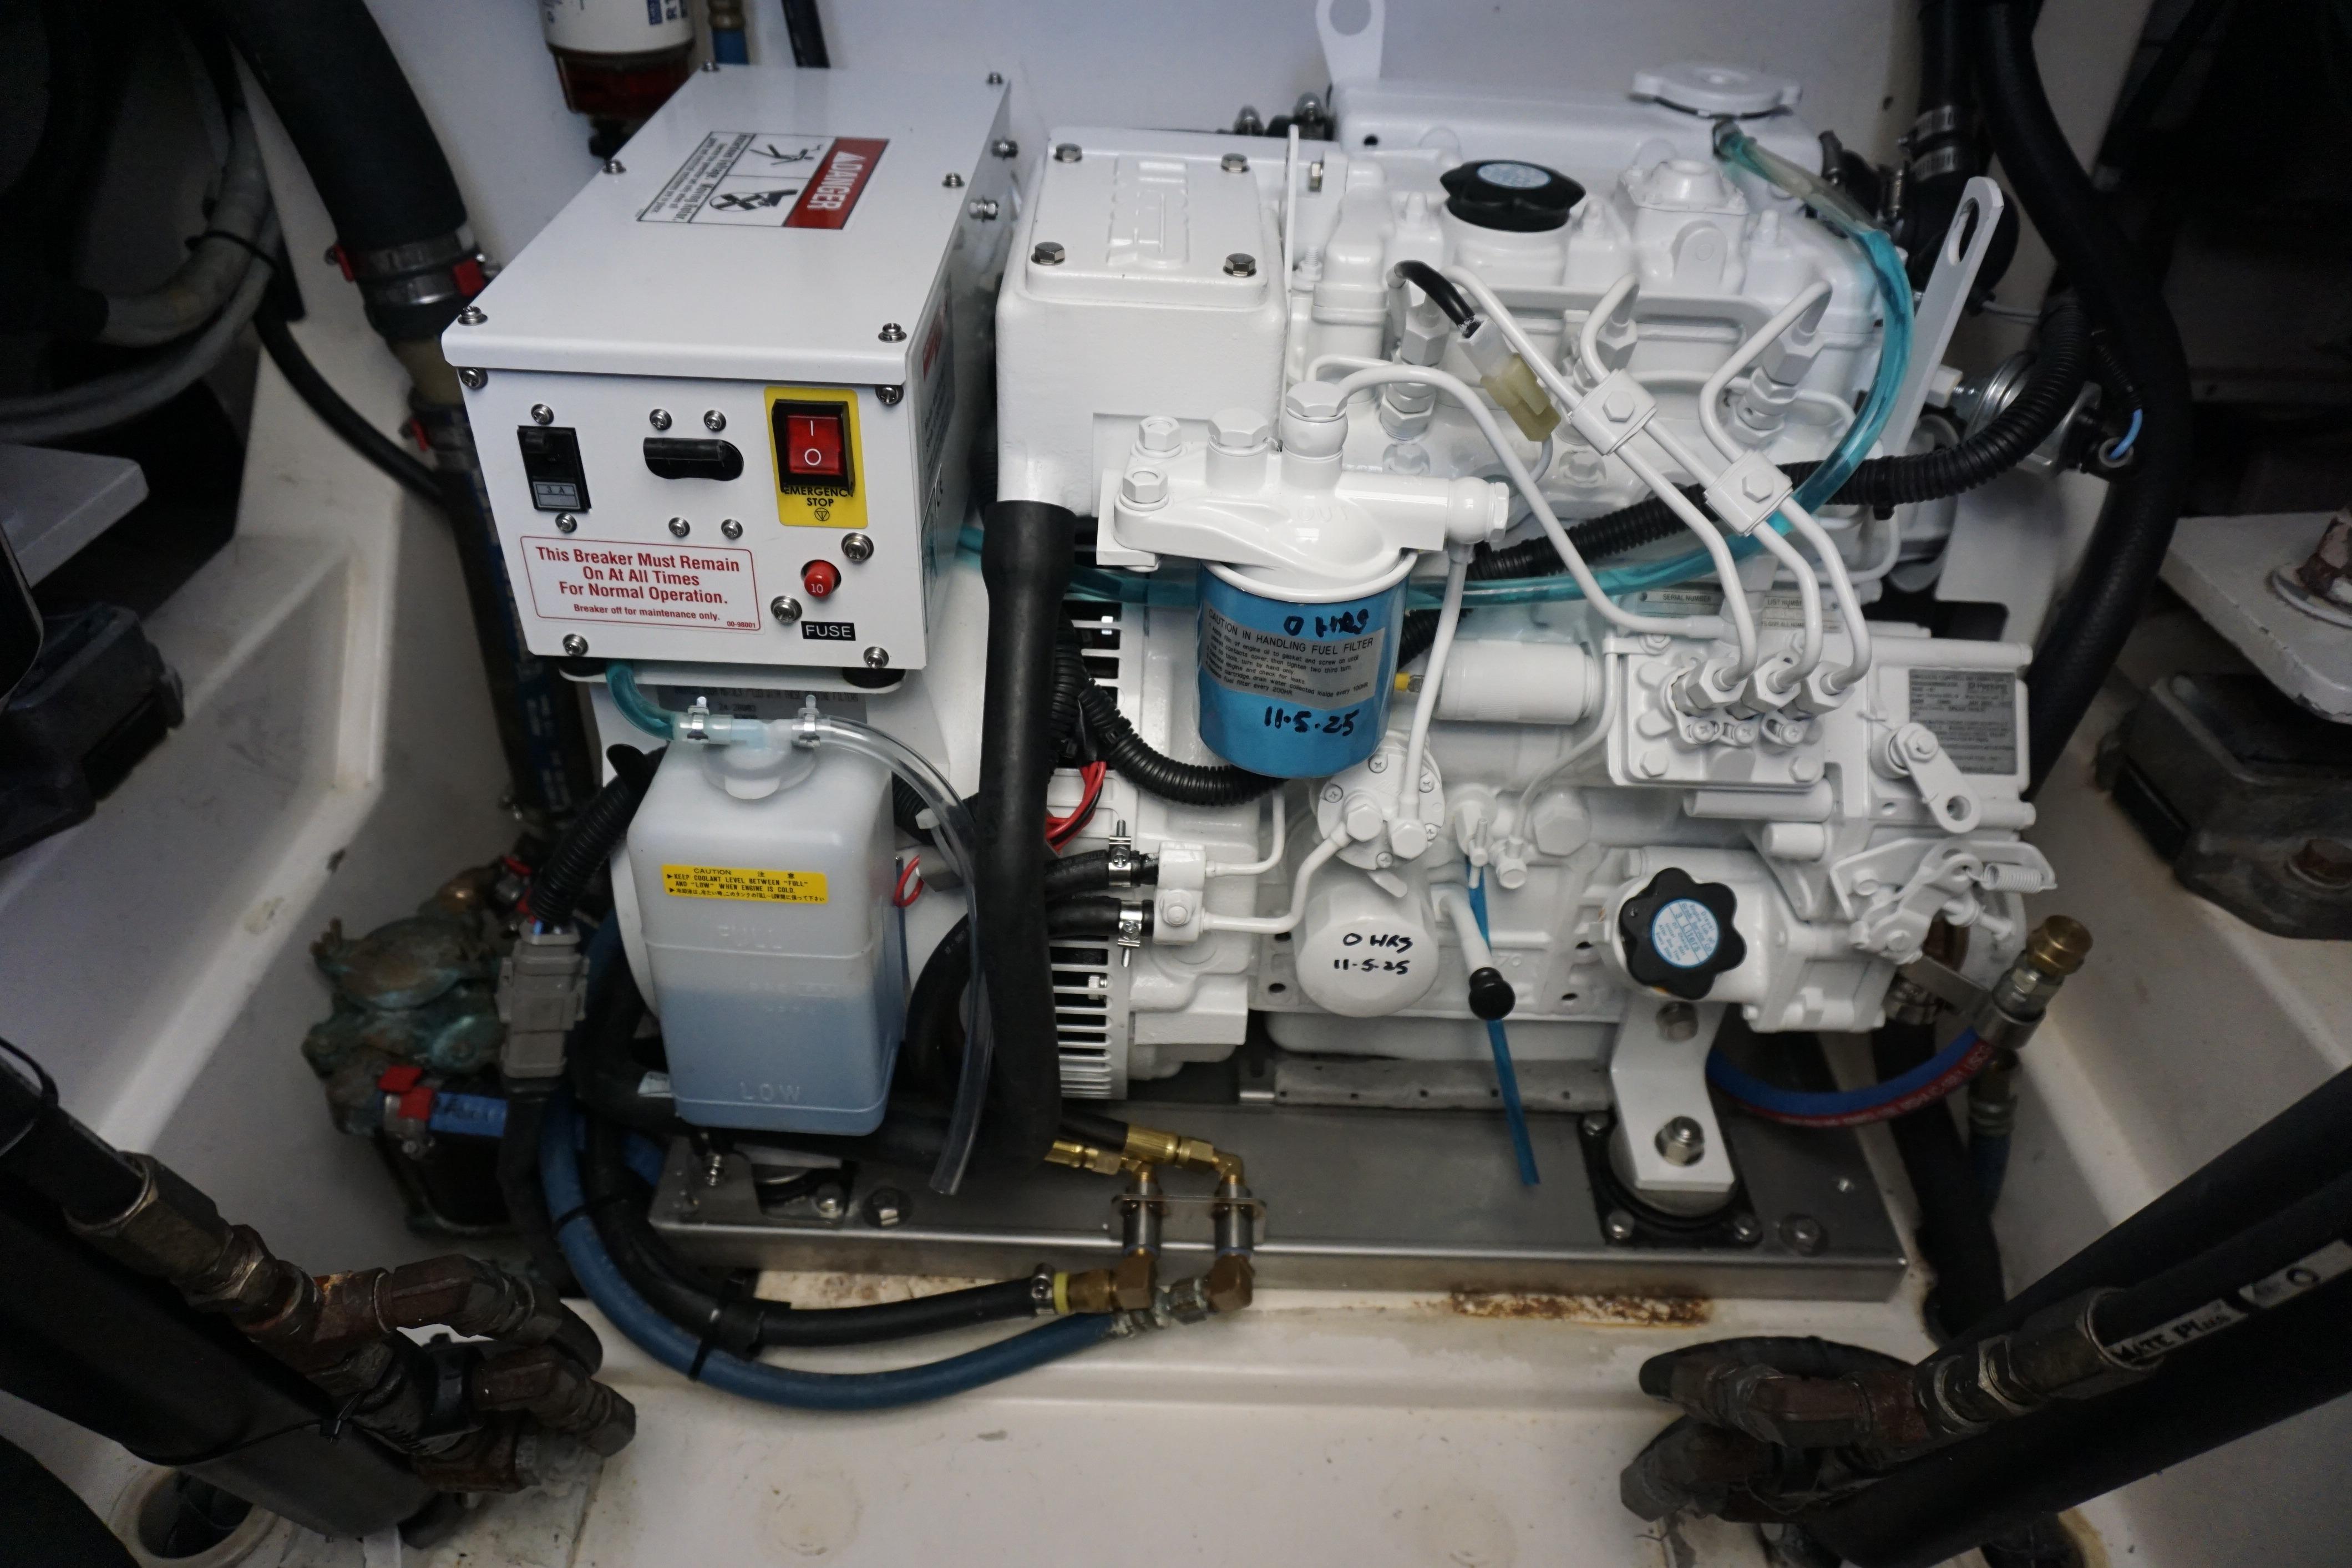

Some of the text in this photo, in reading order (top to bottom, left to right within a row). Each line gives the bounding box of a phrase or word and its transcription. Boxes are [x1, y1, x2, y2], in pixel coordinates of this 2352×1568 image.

[805, 163, 864, 209] DANGER
[807, 498, 834, 506] STOP
[536, 546, 739, 572] This Breaker Must Remain
[583, 566, 699, 586] On At All Times
[559, 581, 728, 604] For Normal Operation.
[811, 584, 823, 593] 10
[574, 603, 608, 613] Breaker
[640, 608, 696, 618] maintenance
[699, 612, 720, 621] only.
[806, 625, 851, 637] FUSE
[1209, 609, 1373, 655] CAUTION IN HANDLING FUEL FILTER
[1225, 645, 1248, 657] contacts
[1287, 660, 1307, 670] tighten
[1226, 662, 1243, 671] engine
[1282, 653, 1302, 661] gasket
[1254, 683, 1269, 691] every
[1273, 686, 1292, 696] 200HR
[1290, 683, 1315, 694] collected
[1681, 923, 1704, 952] Liters
[739, 1081, 800, 1102] LOW
